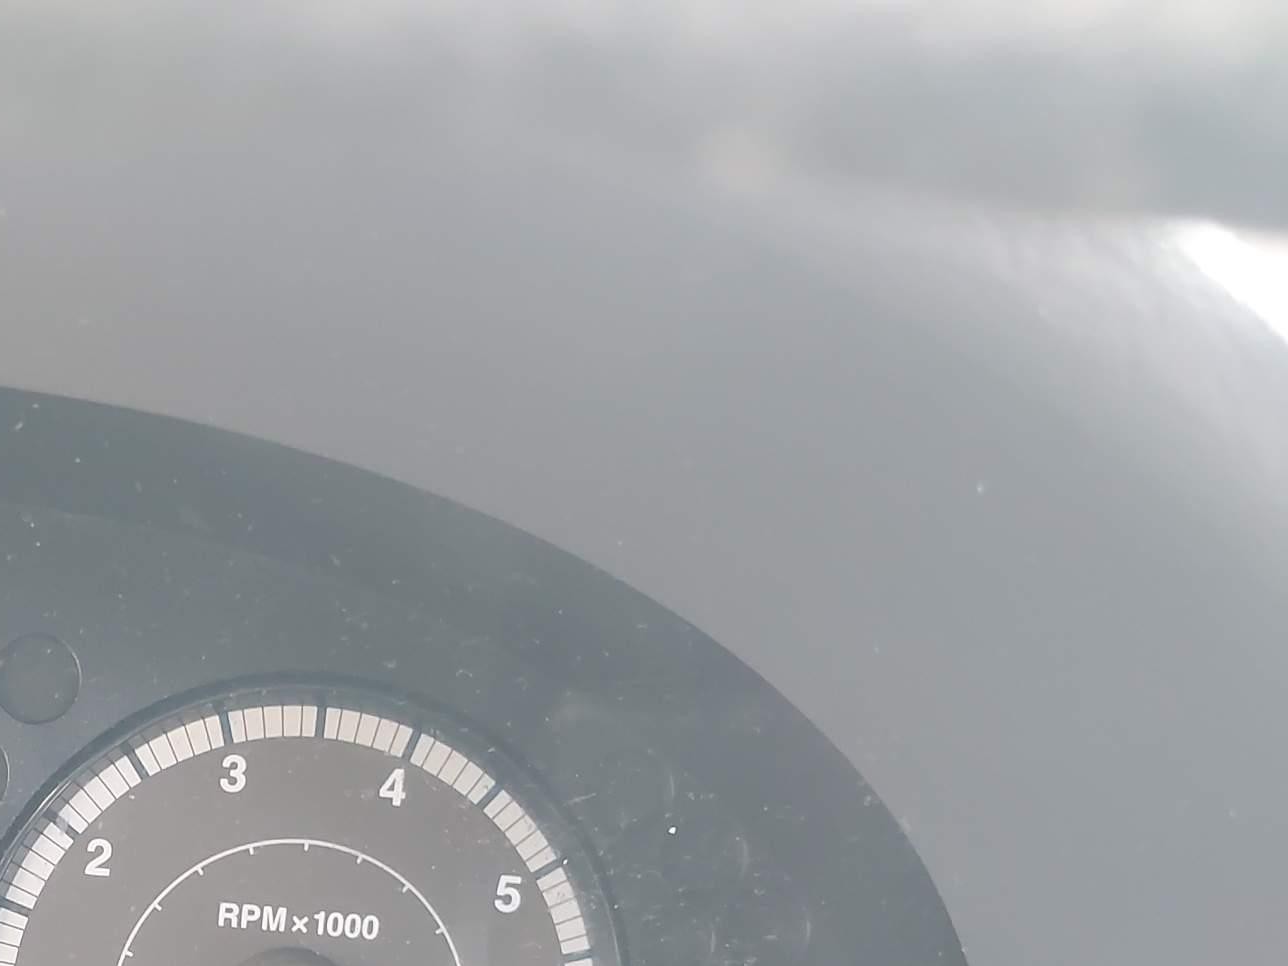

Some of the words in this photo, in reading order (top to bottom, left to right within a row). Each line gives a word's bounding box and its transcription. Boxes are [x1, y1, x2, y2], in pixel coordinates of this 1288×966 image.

[219, 754, 247, 793] 3
[379, 768, 406, 807] 4
[84, 838, 112, 877] 2
[494, 874, 522, 913] 5
